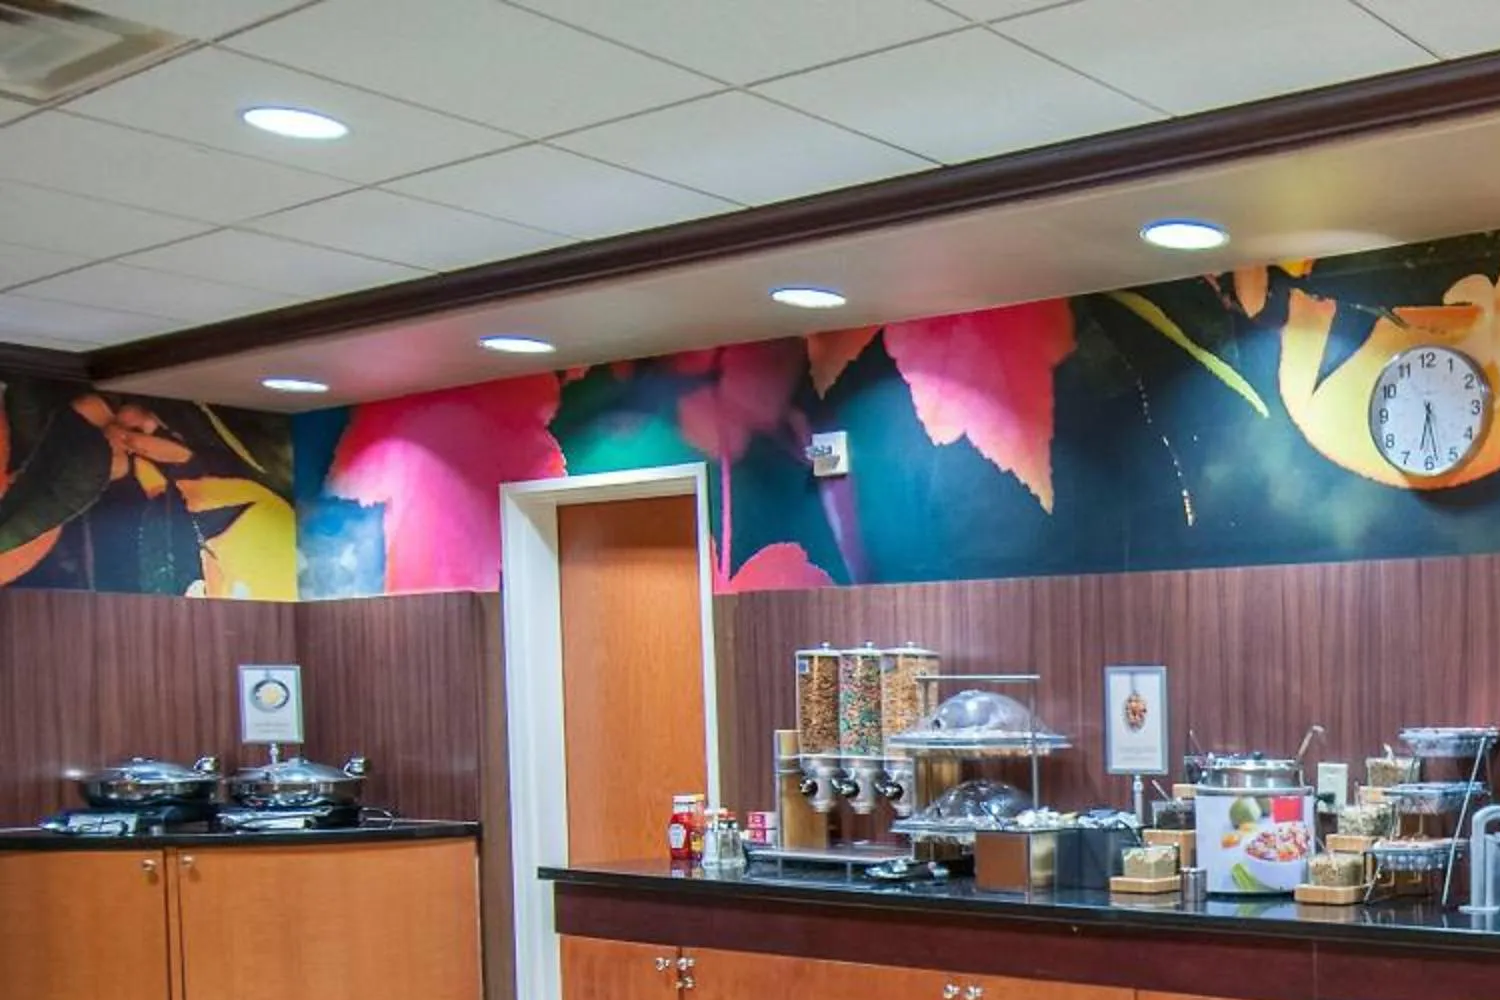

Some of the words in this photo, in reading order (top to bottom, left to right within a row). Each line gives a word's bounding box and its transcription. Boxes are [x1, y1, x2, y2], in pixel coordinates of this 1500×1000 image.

[1418, 352, 1436, 368] 12
[1398, 363, 1411, 378] 11
[1463, 373, 1474, 390] 2
[1383, 384, 1397, 399] 10
[1471, 400, 1481, 415] 3
[1379, 408, 1389, 424] 9
[1463, 426, 1473, 440] 4
[1385, 434, 1395, 448] 8
[1401, 451, 1411, 465] 7
[1448, 447, 1459, 461] 5
[1424, 456, 1435, 471] 6
